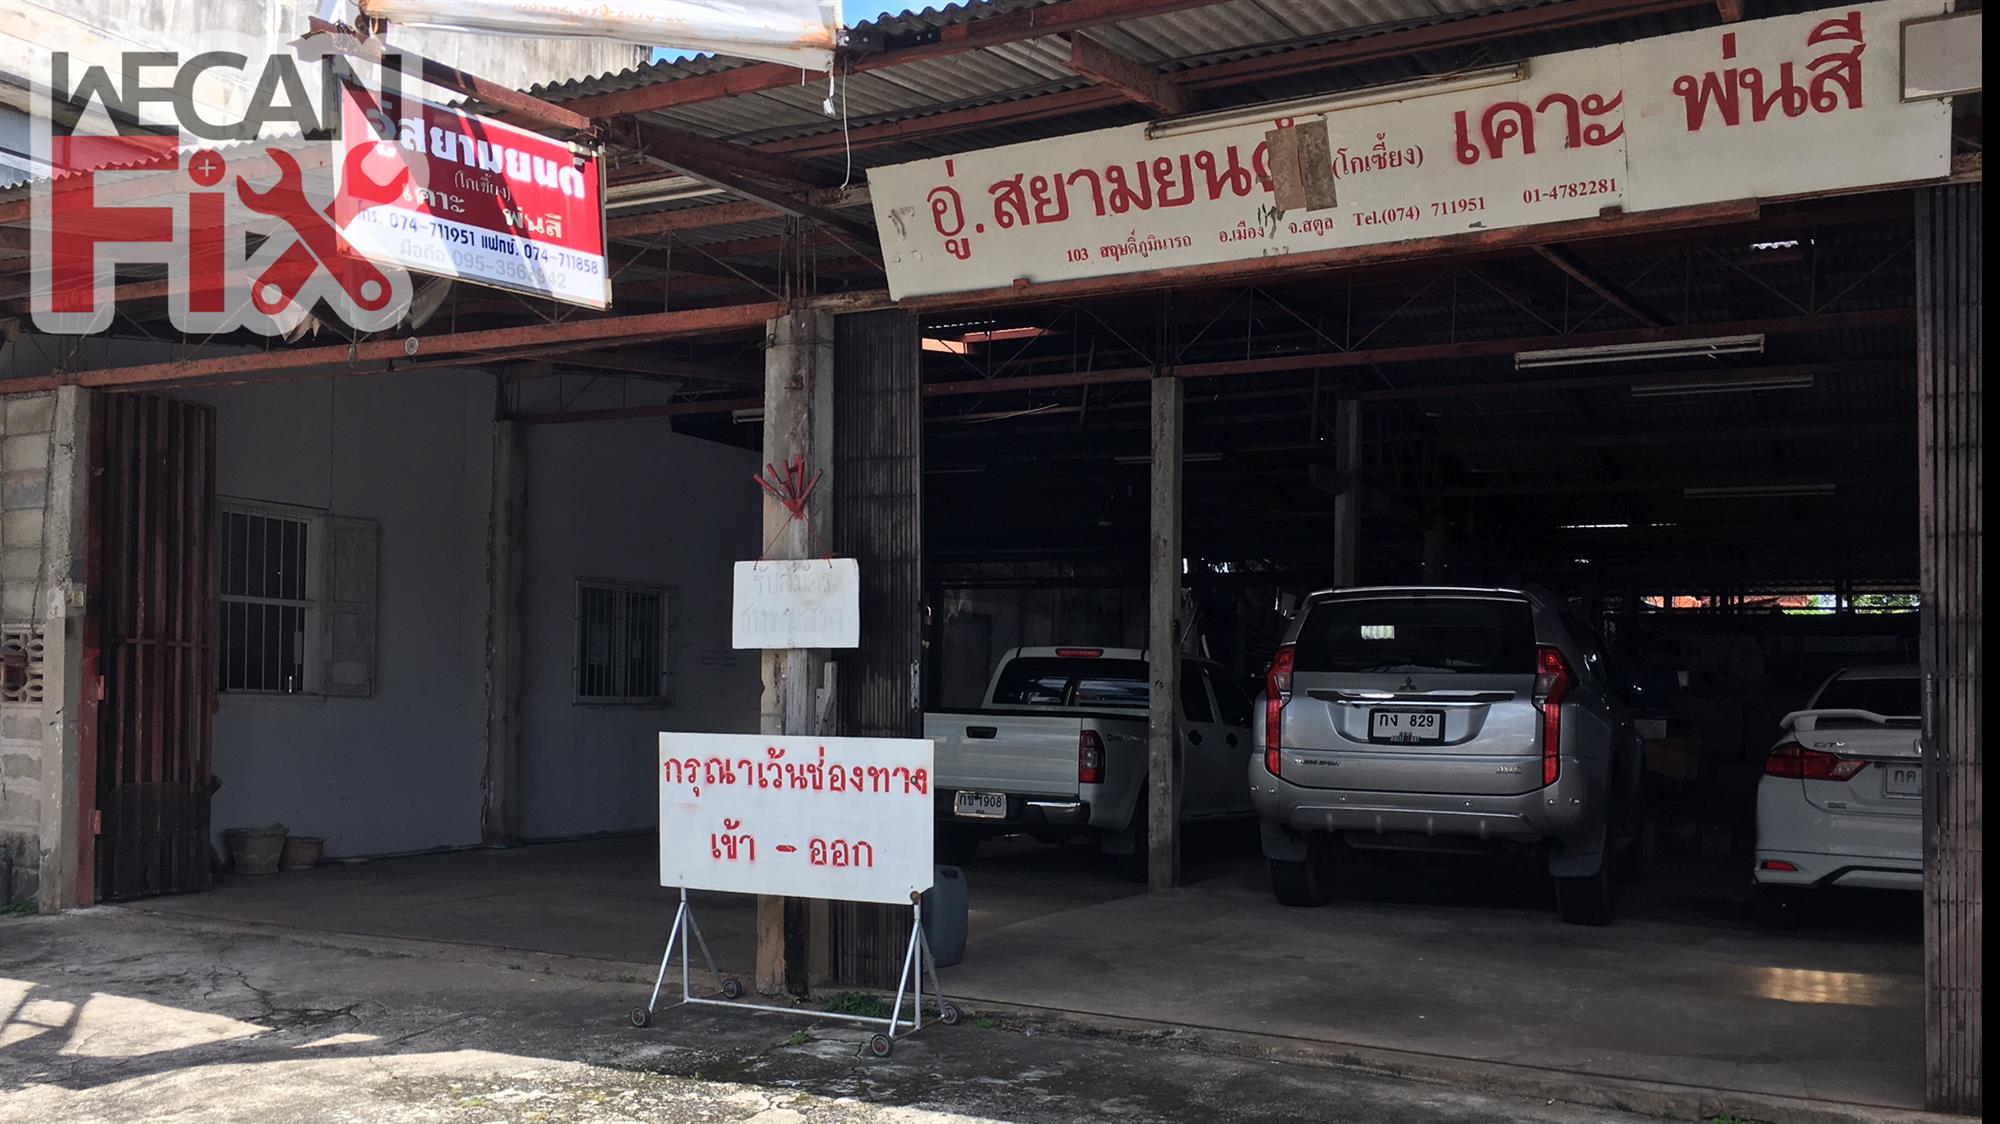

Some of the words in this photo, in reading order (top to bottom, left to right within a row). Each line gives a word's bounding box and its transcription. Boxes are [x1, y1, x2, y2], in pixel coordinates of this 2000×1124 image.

[1454, 88, 1624, 165] เคาะ
[1672, 11, 1866, 132] พ่นสี
[389, 212, 476, 247] 074-711951
[524, 246, 599, 275] 074-711858
[502, 205, 562, 240] พ่นสี
[1066, 248, 1090, 263] 103
[1219, 220, 1266, 243] อ.เมือง
[1288, 216, 1334, 238] จ.สตูล
[1431, 197, 1486, 217] 711951
[1522, 177, 1618, 205] 01-4782281
[1379, 714, 1399, 728] กง
[1409, 714, 1435, 728] 829
[663, 746, 929, 797] กรุณาเว้นช่องทาง
[979, 794, 1003, 809] 1908
[711, 818, 756, 861] เข้า
[809, 838, 874, 868] ออก
